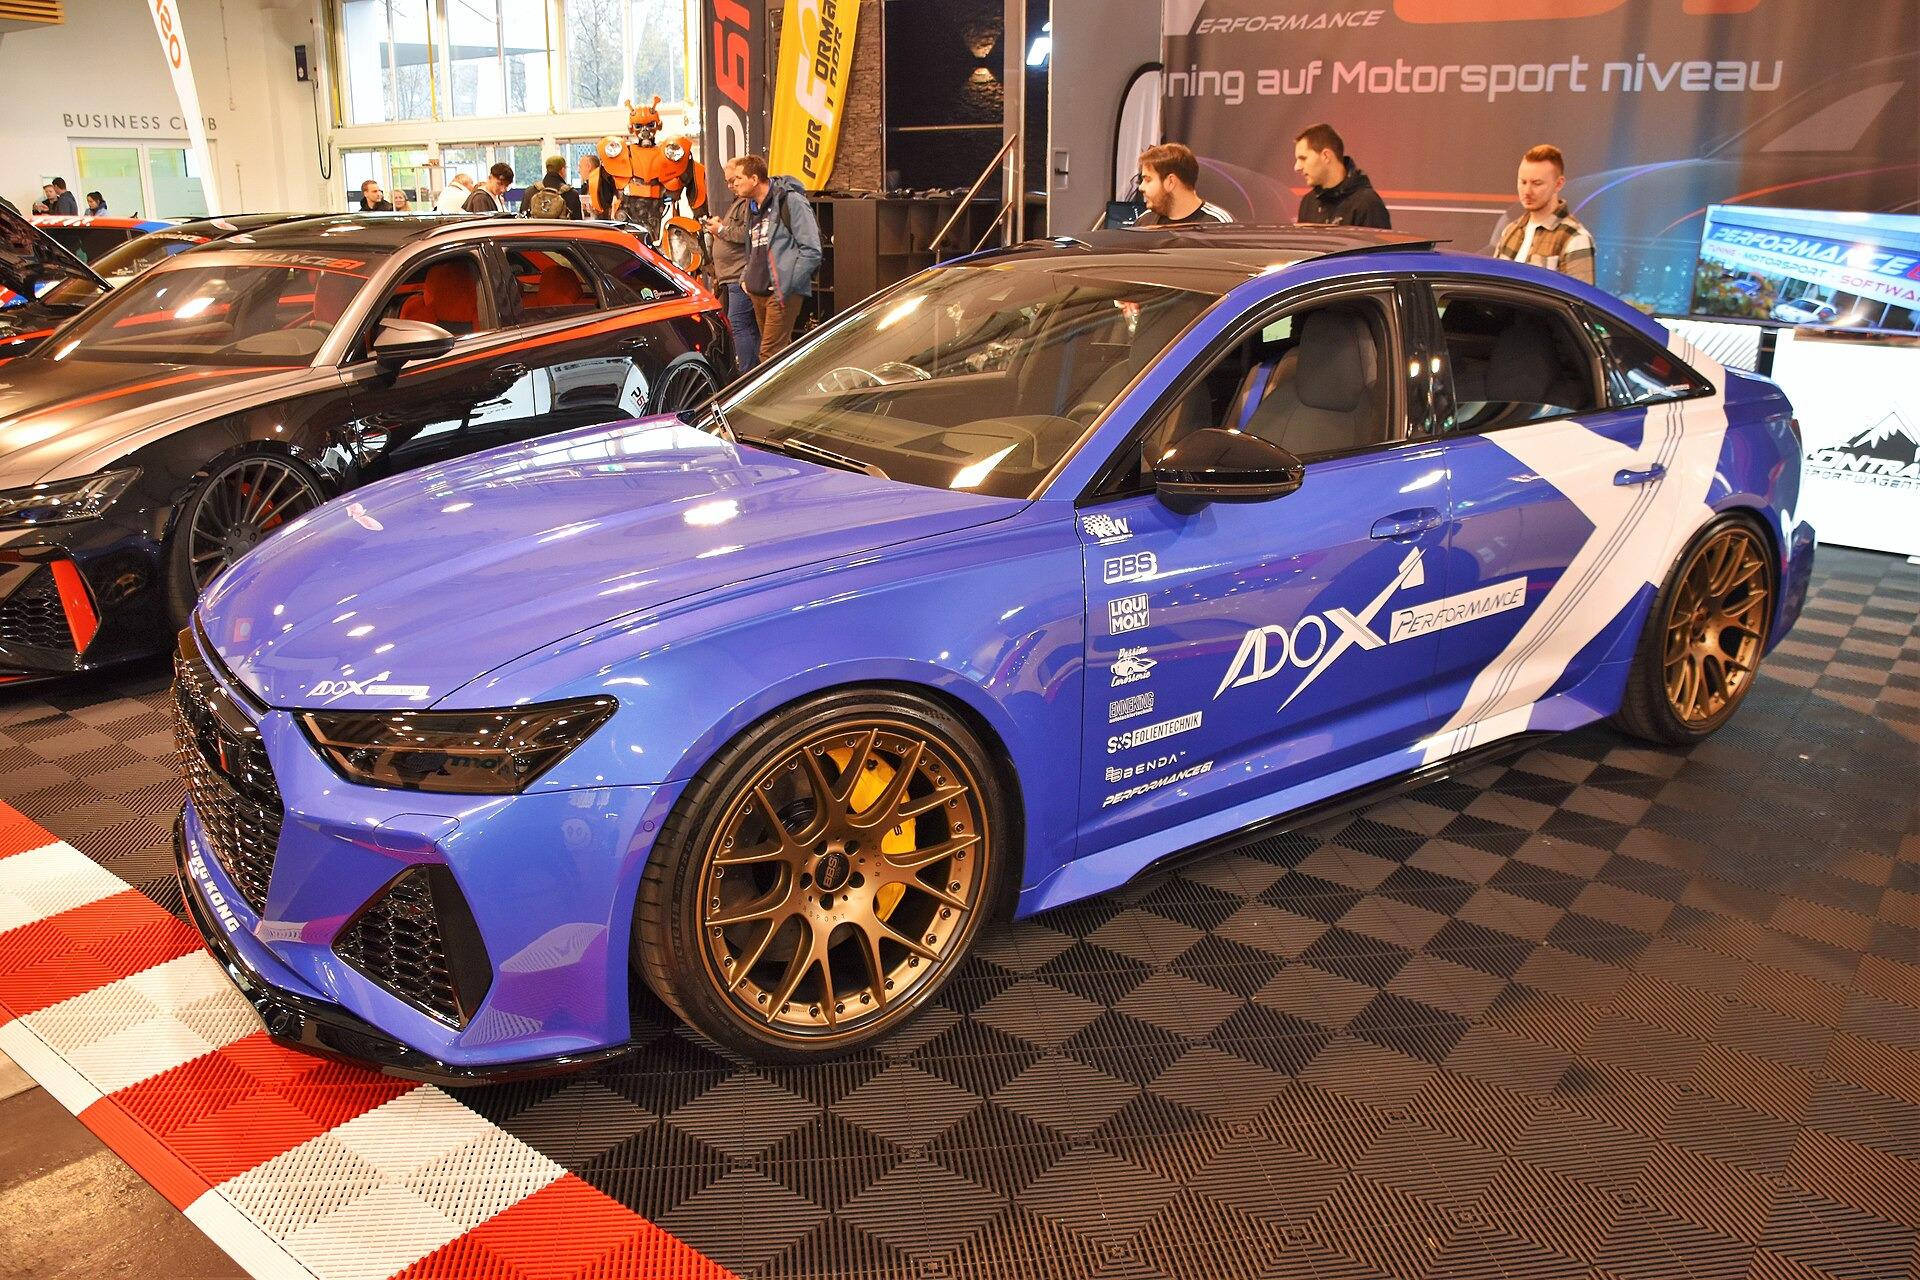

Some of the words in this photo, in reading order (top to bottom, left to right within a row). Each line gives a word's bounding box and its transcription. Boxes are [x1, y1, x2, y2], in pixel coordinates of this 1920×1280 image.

[1257, 60, 1323, 95] auf
[1331, 55, 1589, 103] Motorsport
[1601, 53, 1784, 92] niveau
[63, 113, 161, 130] BUSINESS
[1839, 274, 1920, 302] SOFTWA
[1105, 553, 1152, 580] BBS
[1110, 595, 1147, 617] LIQUI
[1394, 587, 1524, 640] PERFORMANCE
[1111, 611, 1149, 633] MOLY
[1134, 713, 1200, 745] FOLIENTECHNIK
[1123, 753, 1178, 779] BENDA
[823, 856, 839, 888] BBS
[203, 880, 241, 934] KONG
